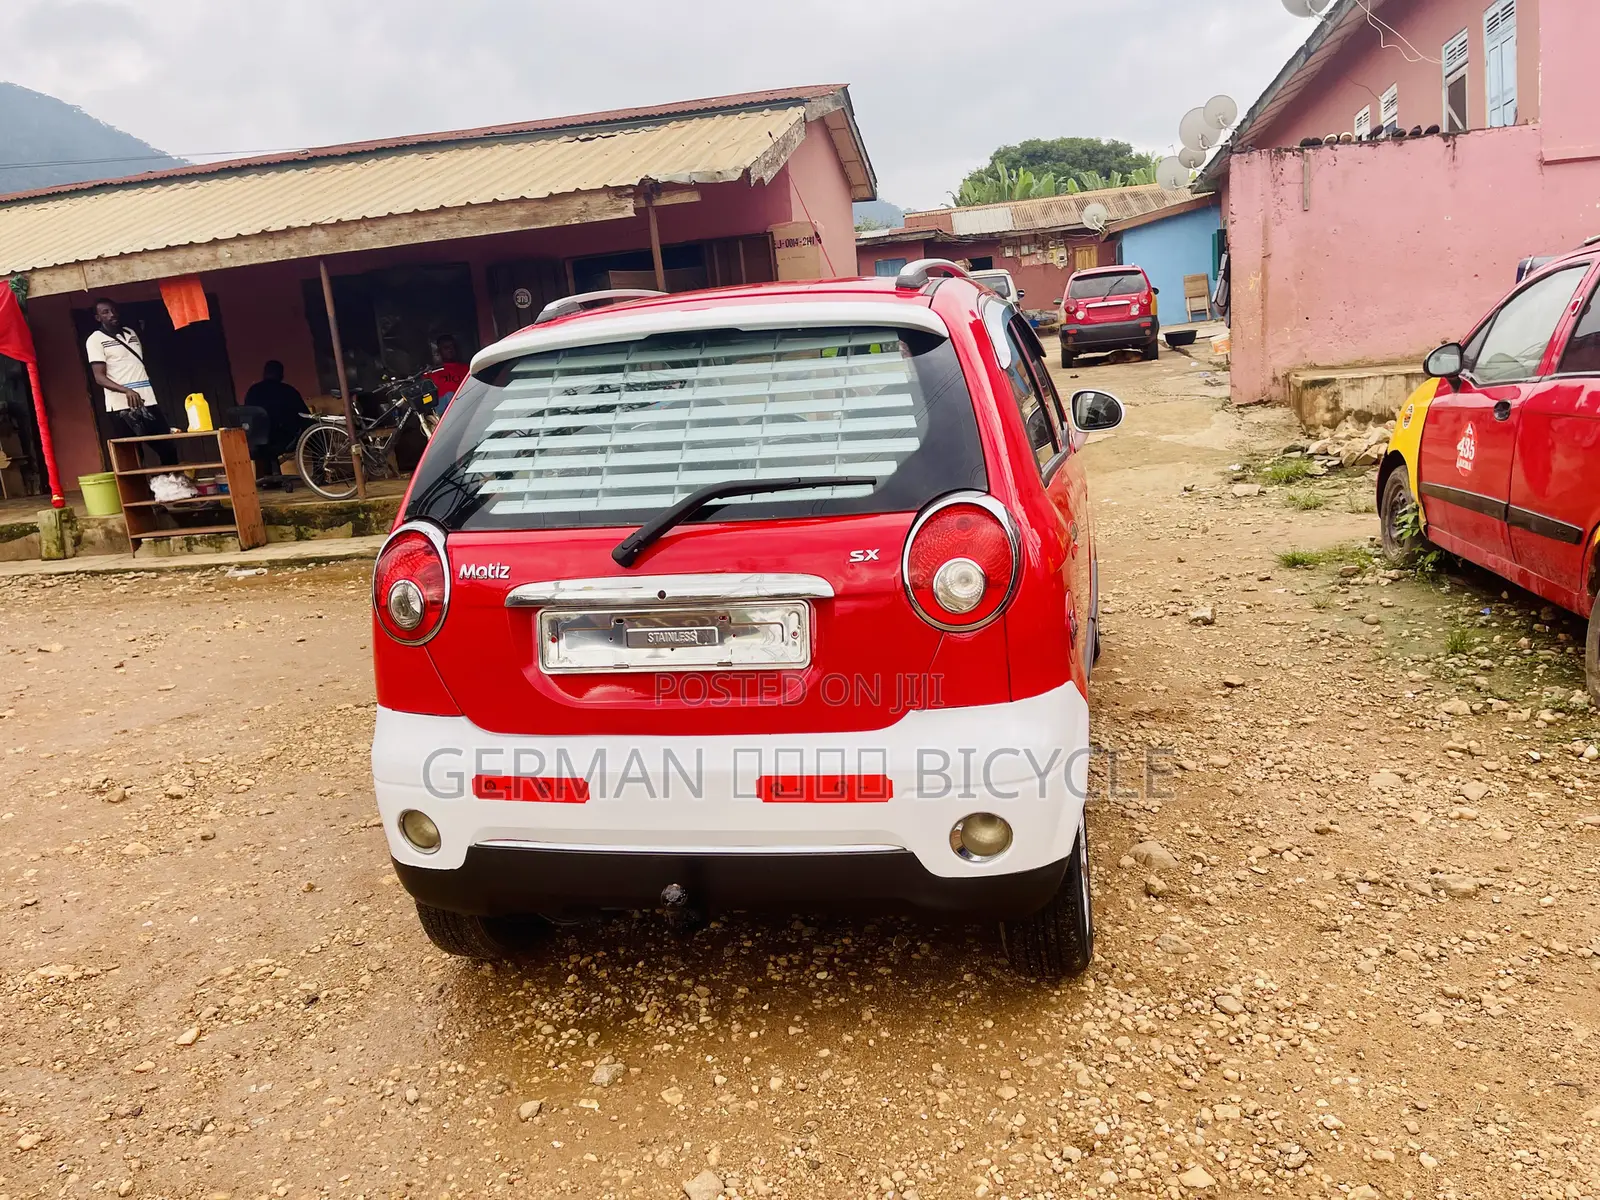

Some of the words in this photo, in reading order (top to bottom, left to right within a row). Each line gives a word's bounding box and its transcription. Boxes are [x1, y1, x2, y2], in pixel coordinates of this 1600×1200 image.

[849, 548, 880, 563] SX
[458, 562, 511, 579] Matiz
[647, 631, 697, 643] STAINLESS
